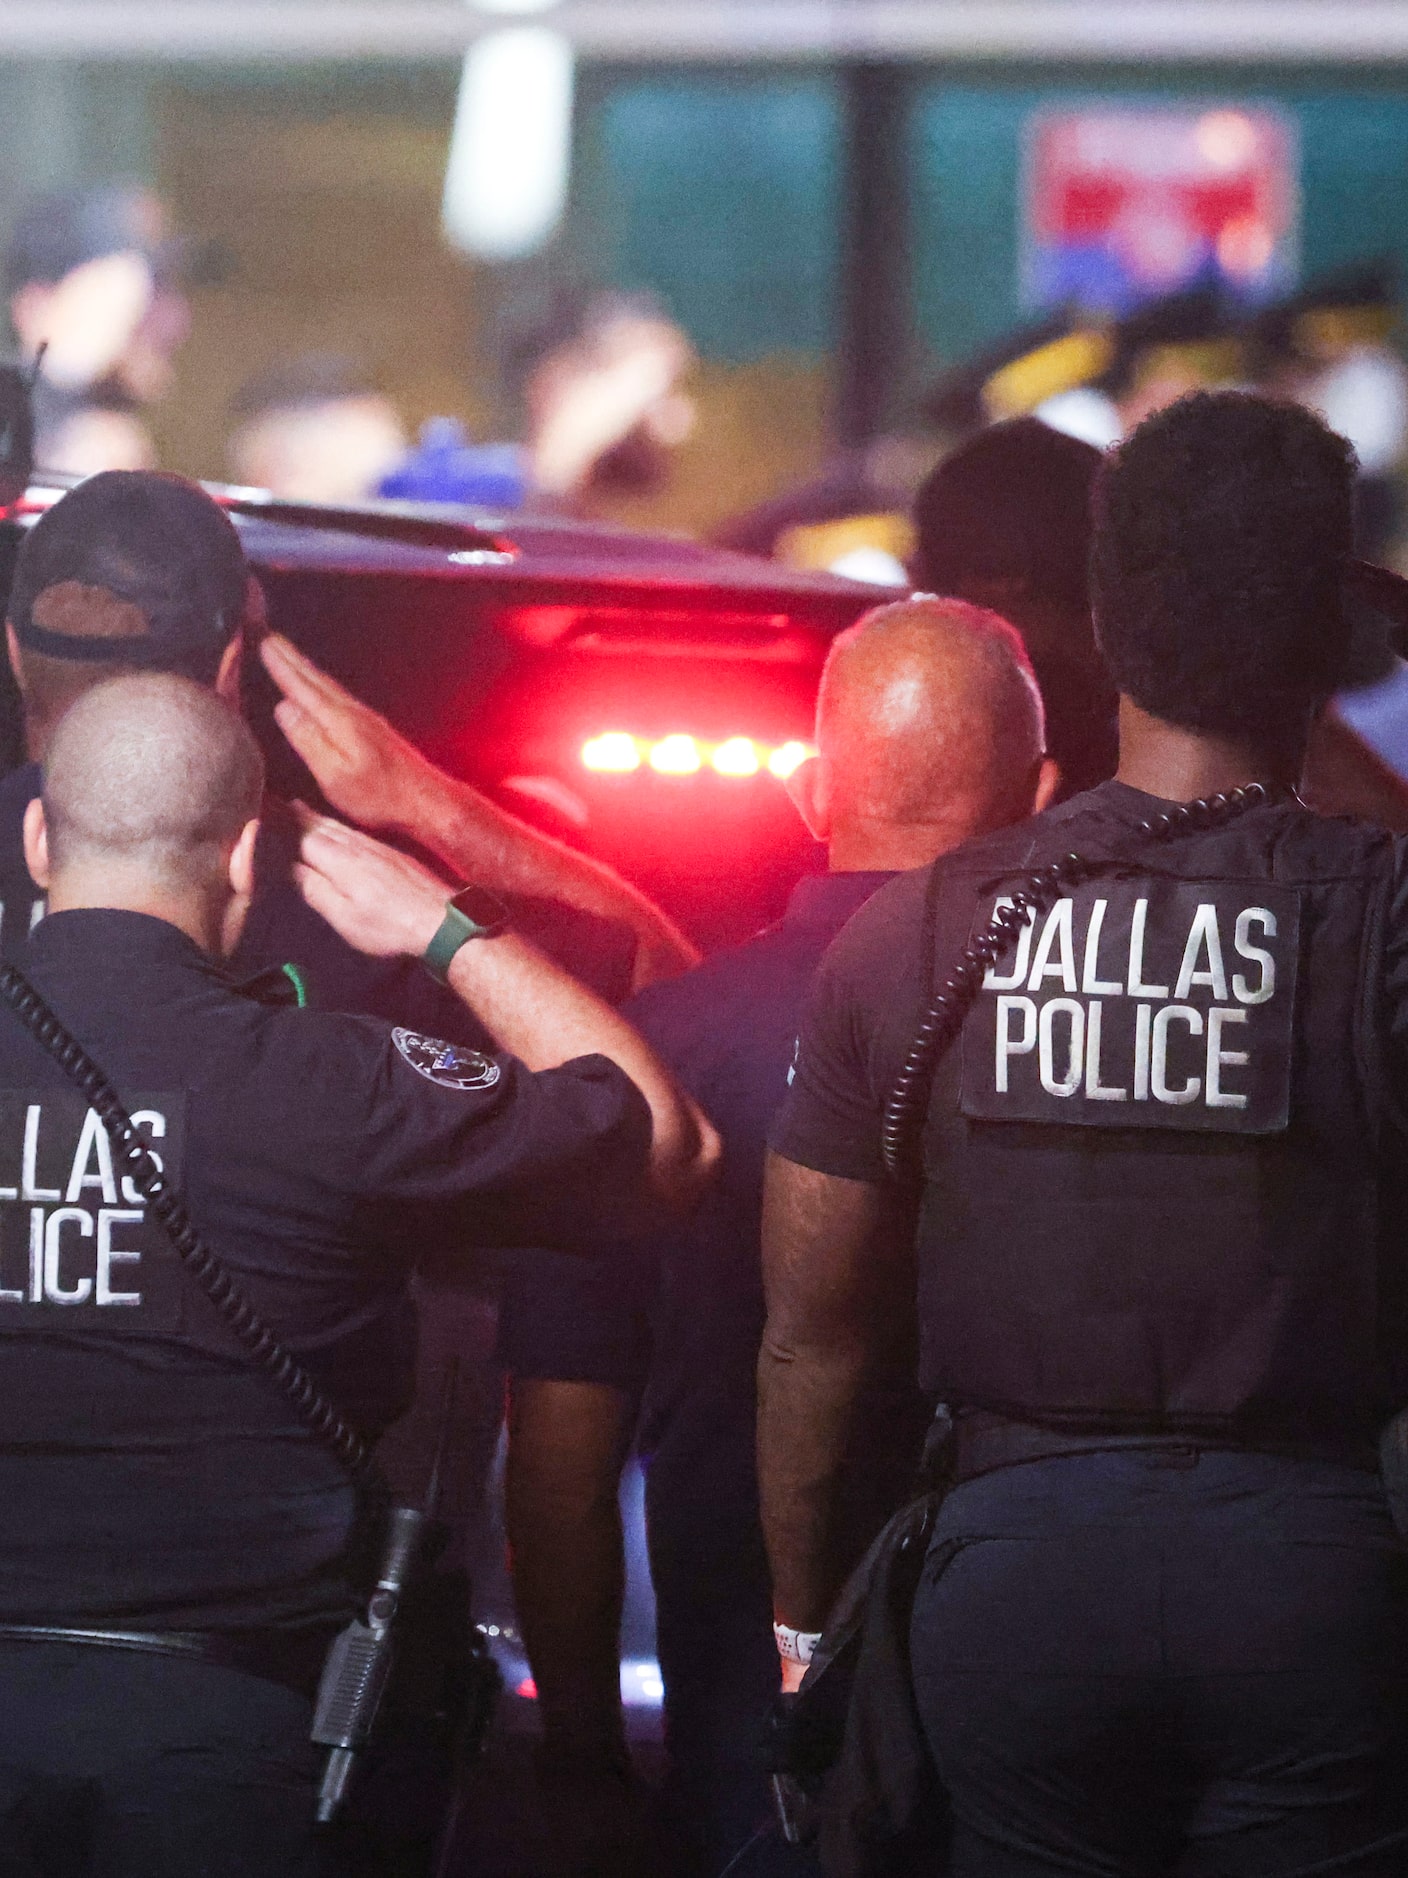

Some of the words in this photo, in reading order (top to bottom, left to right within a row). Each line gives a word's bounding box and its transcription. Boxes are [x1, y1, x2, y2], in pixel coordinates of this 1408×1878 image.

[982, 896, 1278, 1005] DALLAS
[995, 995, 1250, 1109] POLICE
[0, 1104, 166, 1204] LAS
[0, 1206, 145, 1306] ICE
